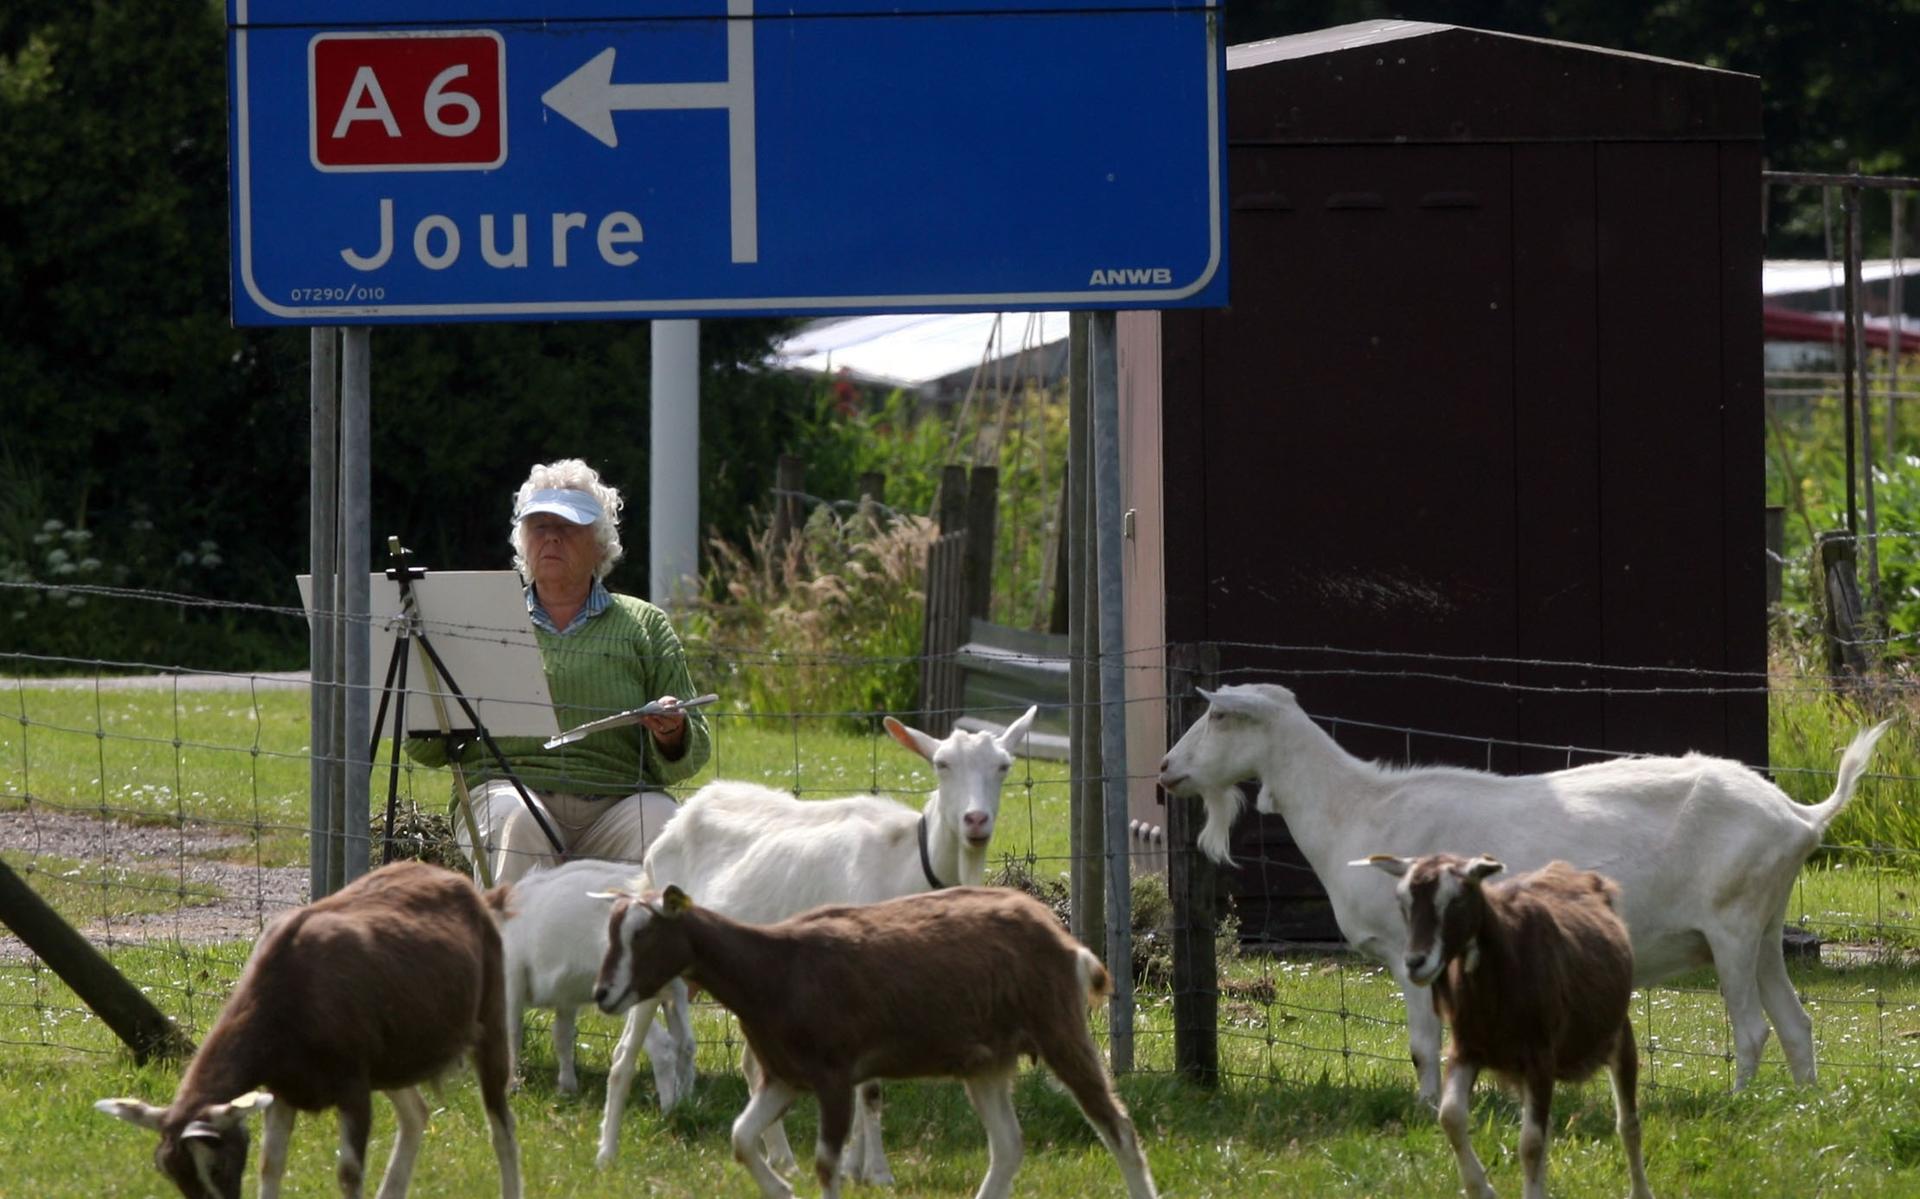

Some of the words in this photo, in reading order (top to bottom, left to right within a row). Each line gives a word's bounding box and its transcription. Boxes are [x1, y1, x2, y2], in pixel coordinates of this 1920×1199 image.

[340, 198, 644, 271] Joure
[1089, 268, 1173, 286] ANWB
[291, 283, 386, 302] 07290/010
